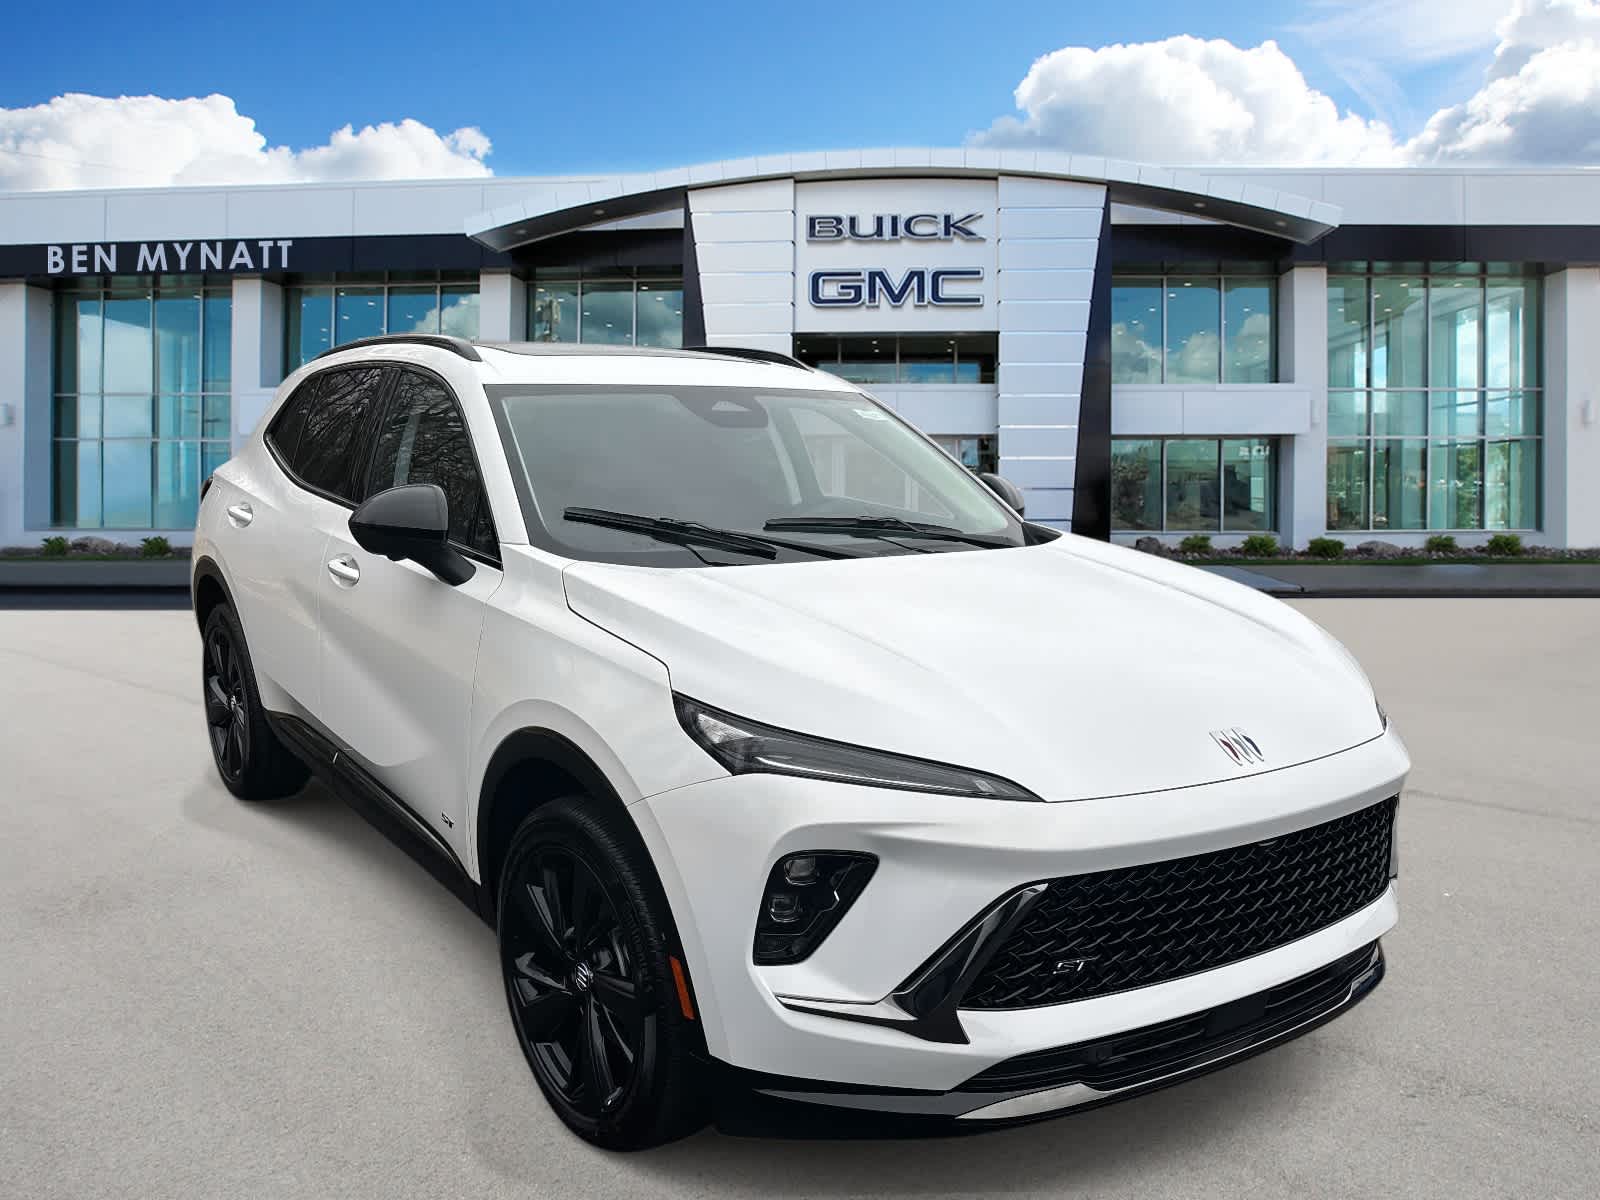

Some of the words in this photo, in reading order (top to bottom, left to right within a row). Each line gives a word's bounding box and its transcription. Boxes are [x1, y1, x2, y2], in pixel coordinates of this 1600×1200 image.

[806, 213, 986, 242] BUICK
[47, 244, 117, 273] BEN
[136, 240, 293, 271] MYNATT
[808, 267, 984, 307] GMC
